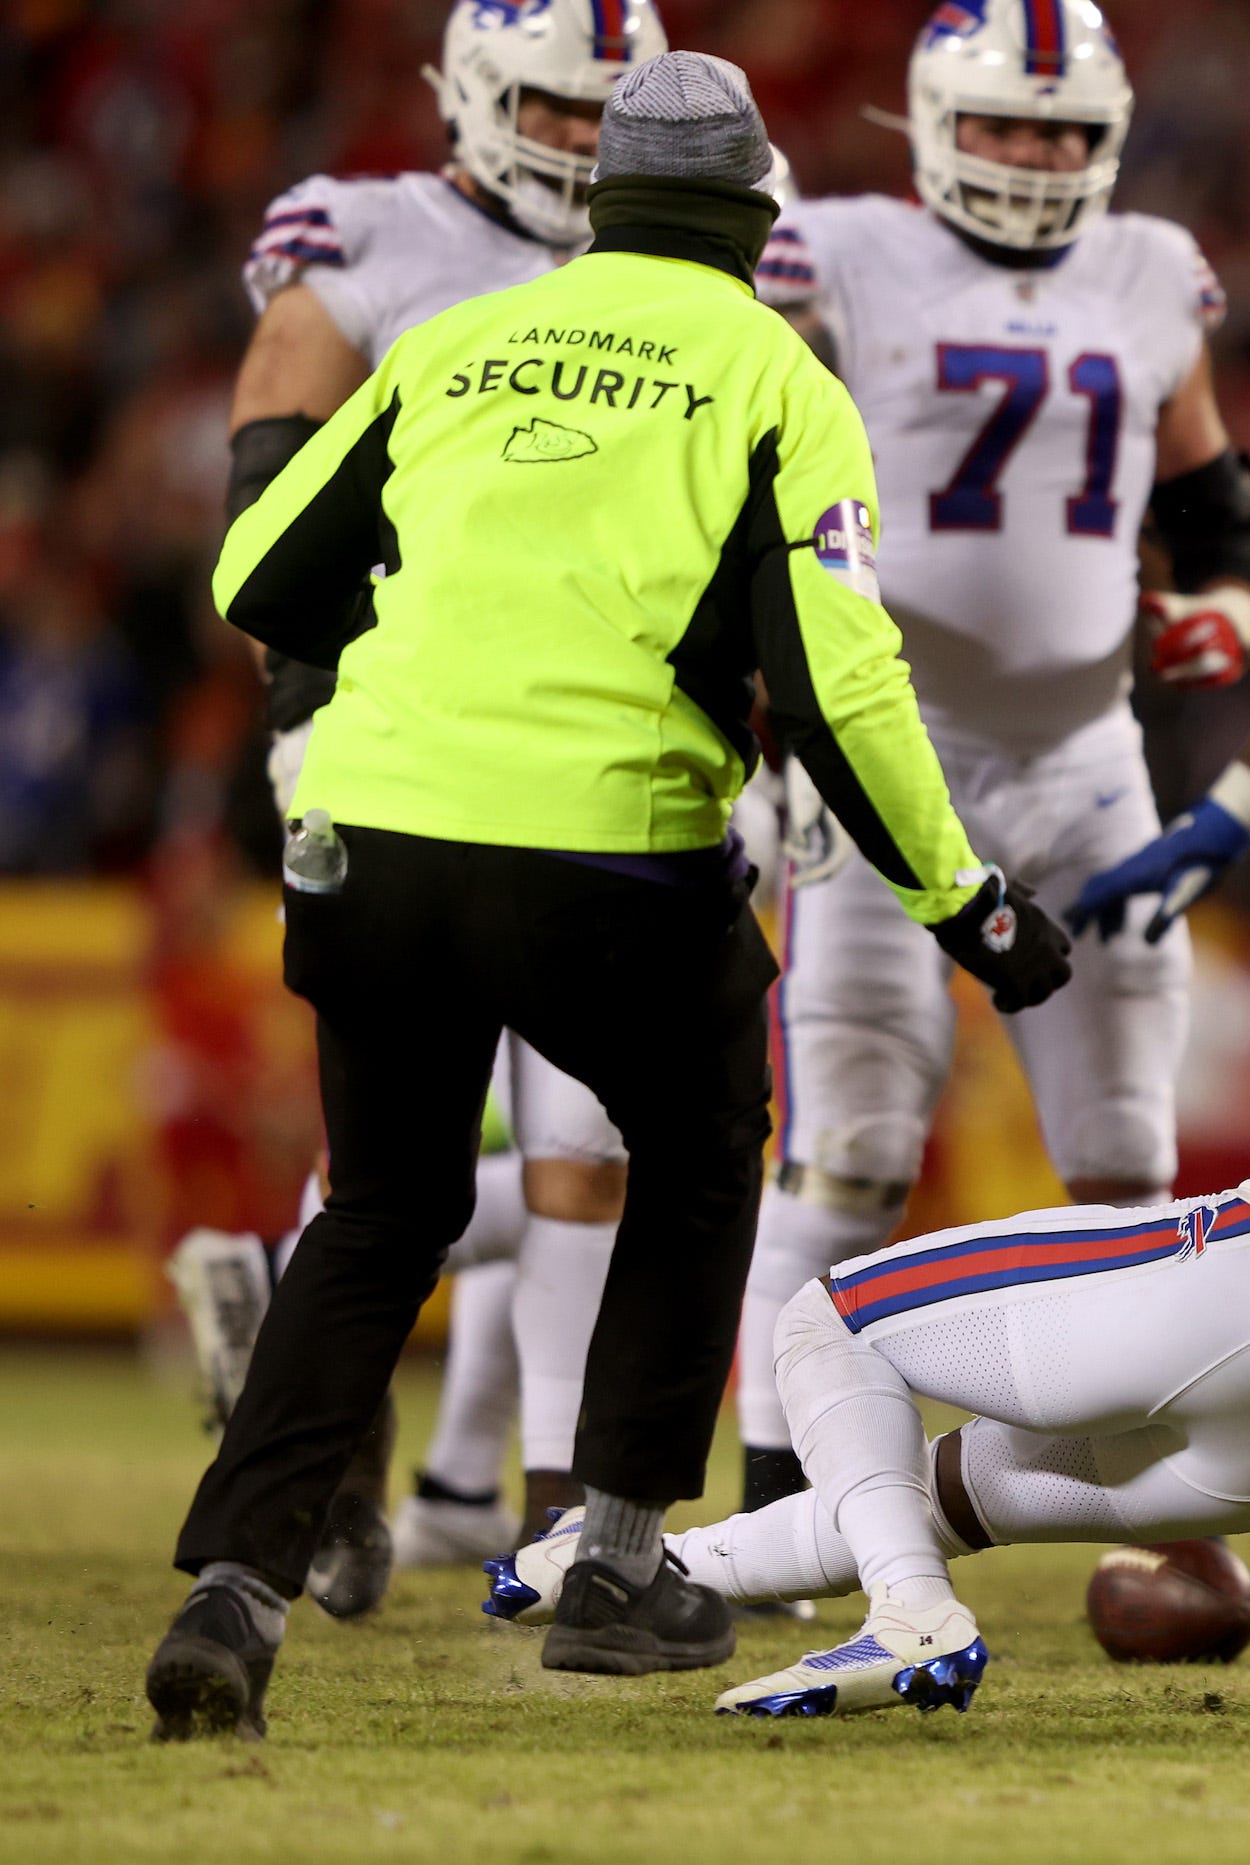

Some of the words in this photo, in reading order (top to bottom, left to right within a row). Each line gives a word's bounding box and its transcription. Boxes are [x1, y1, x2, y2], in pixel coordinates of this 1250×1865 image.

[507, 327, 679, 367] LANDMARK
[445, 358, 716, 421] SECURITY
[928, 341, 1125, 538] 71
[919, 1635, 933, 1646] 14
